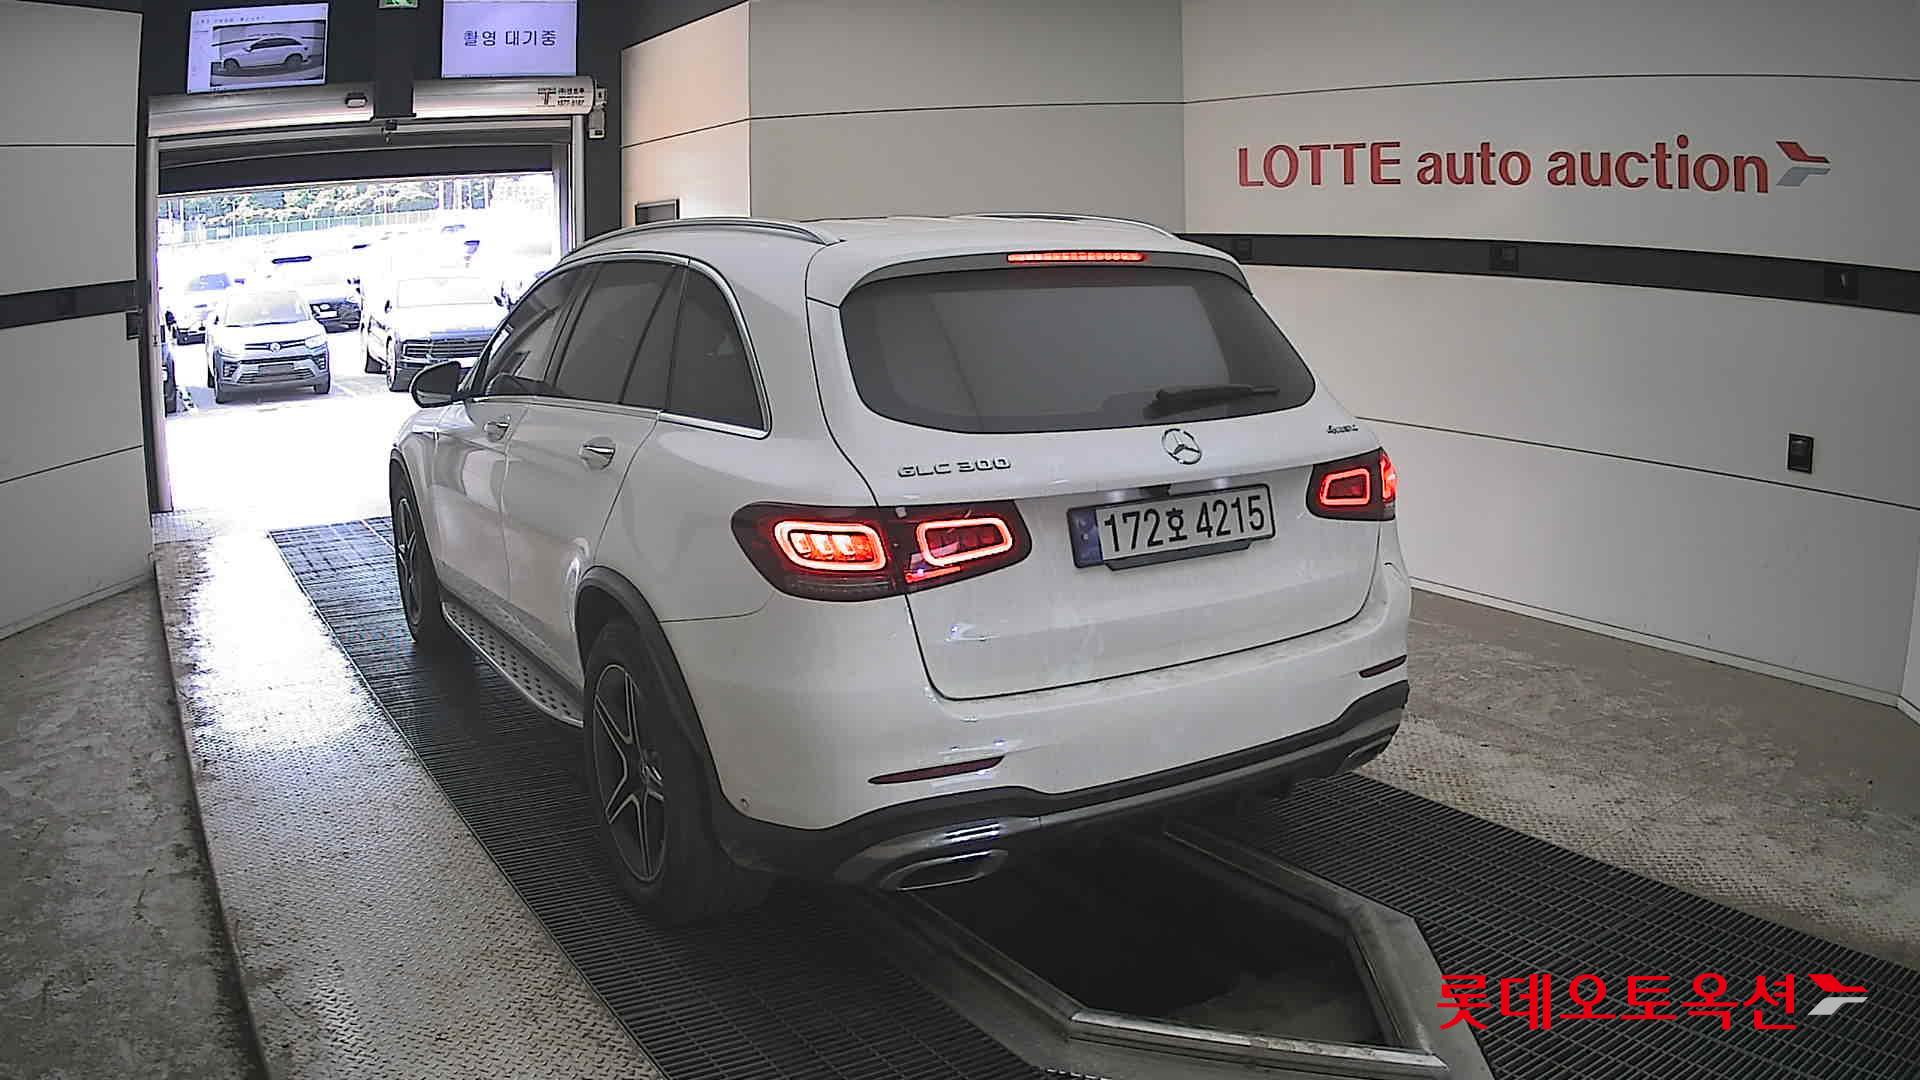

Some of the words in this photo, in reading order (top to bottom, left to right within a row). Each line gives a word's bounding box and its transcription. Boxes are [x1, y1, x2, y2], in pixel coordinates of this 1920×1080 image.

[463, 30, 496, 47] 촬영
[505, 29, 557, 47] 대기중
[1238, 141, 1401, 188] LOTTE
[1417, 141, 1531, 186] auto
[1547, 134, 1769, 194] auction
[897, 463, 952, 478] GLC
[955, 457, 1011, 473] 300
[1104, 507, 1188, 552] 172호
[1196, 495, 1265, 538] 4215
